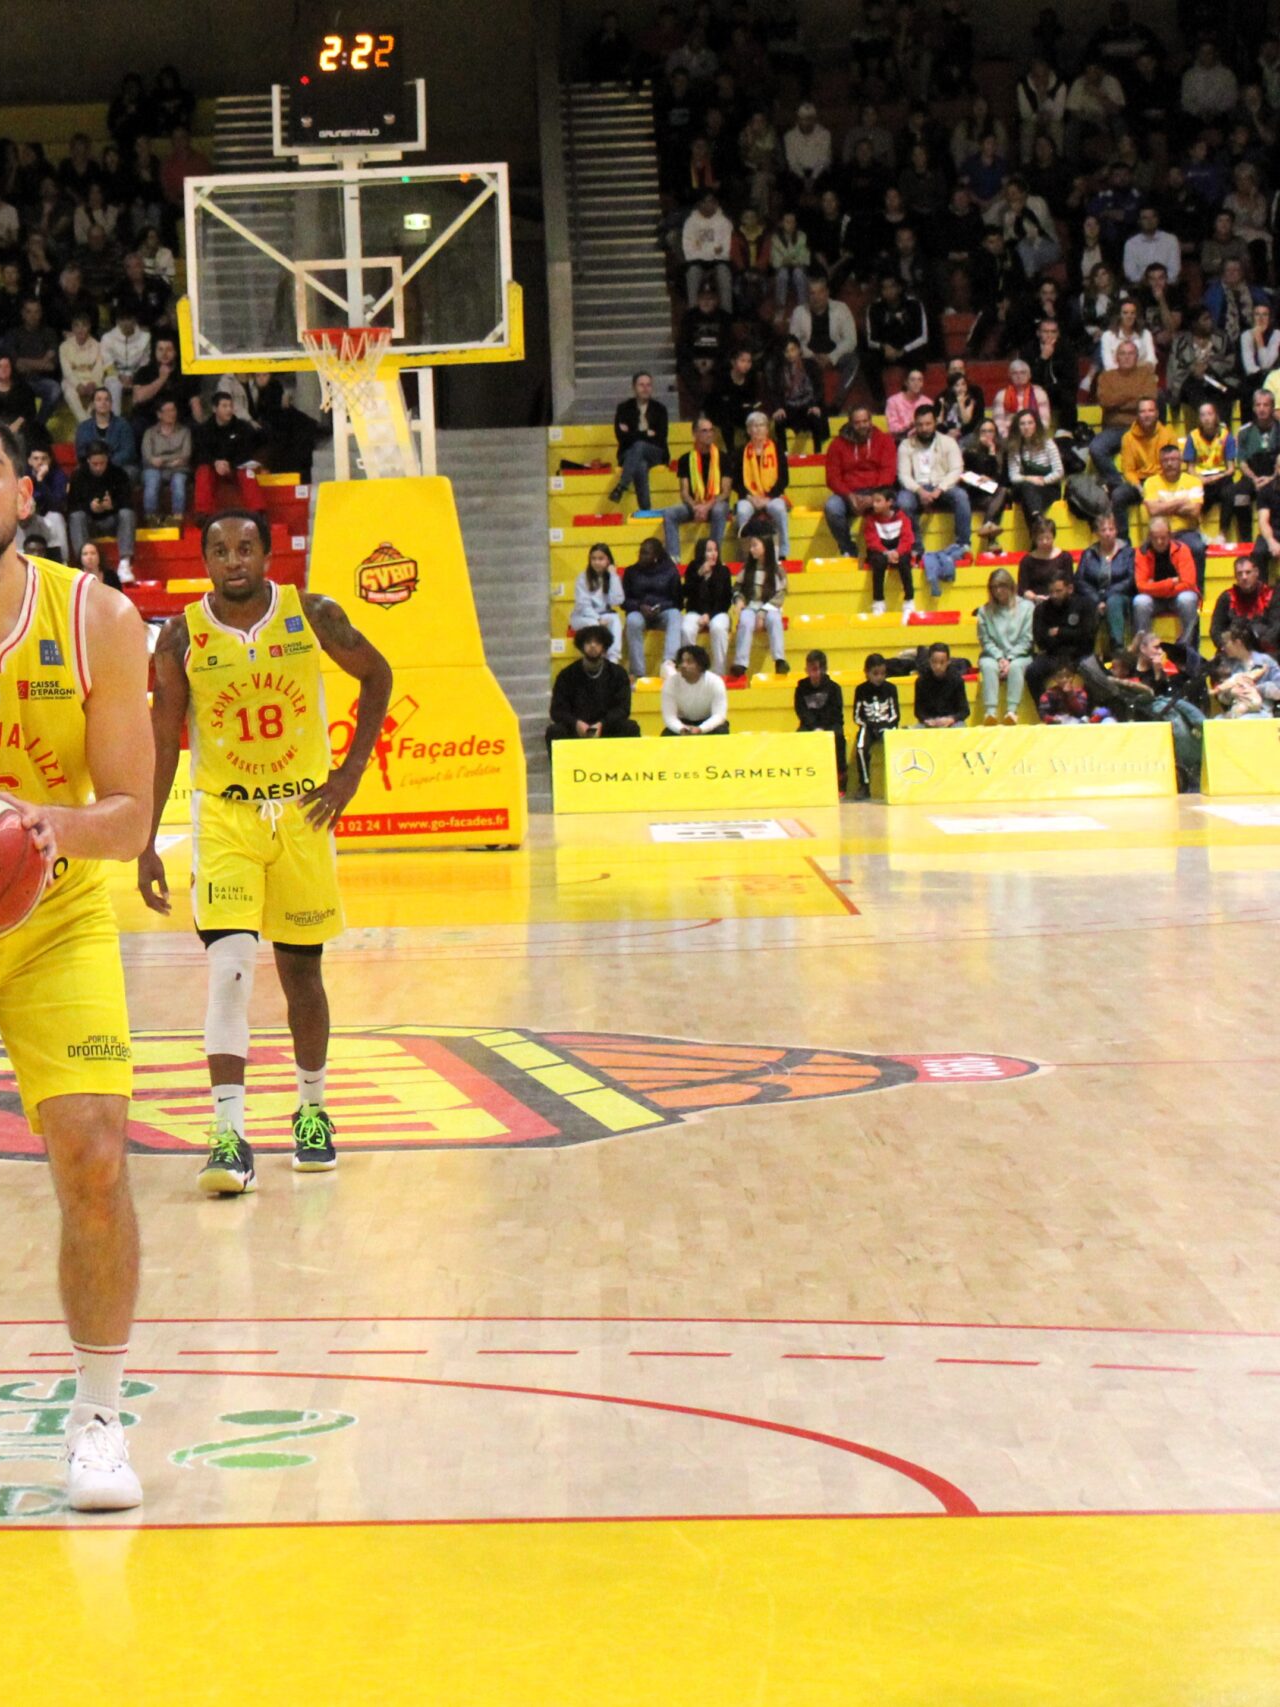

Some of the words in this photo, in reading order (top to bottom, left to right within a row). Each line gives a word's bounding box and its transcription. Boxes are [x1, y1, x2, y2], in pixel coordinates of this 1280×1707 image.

[319, 34, 395, 71] 2:22
[30, 680, 60, 688] CAISSE
[211, 671, 307, 729] SAINT-VALLIER
[235, 704, 284, 742] 18
[397, 734, 506, 764] Façades
[226, 750, 265, 775] BASKET
[252, 778, 316, 801] AÉSIO
[348, 820, 363, 832] 02
[366, 819, 381, 831] 24
[397, 814, 506, 830] www.go-facades.fr
[214, 886, 245, 894] SAINT
[215, 893, 254, 902] VALLIER
